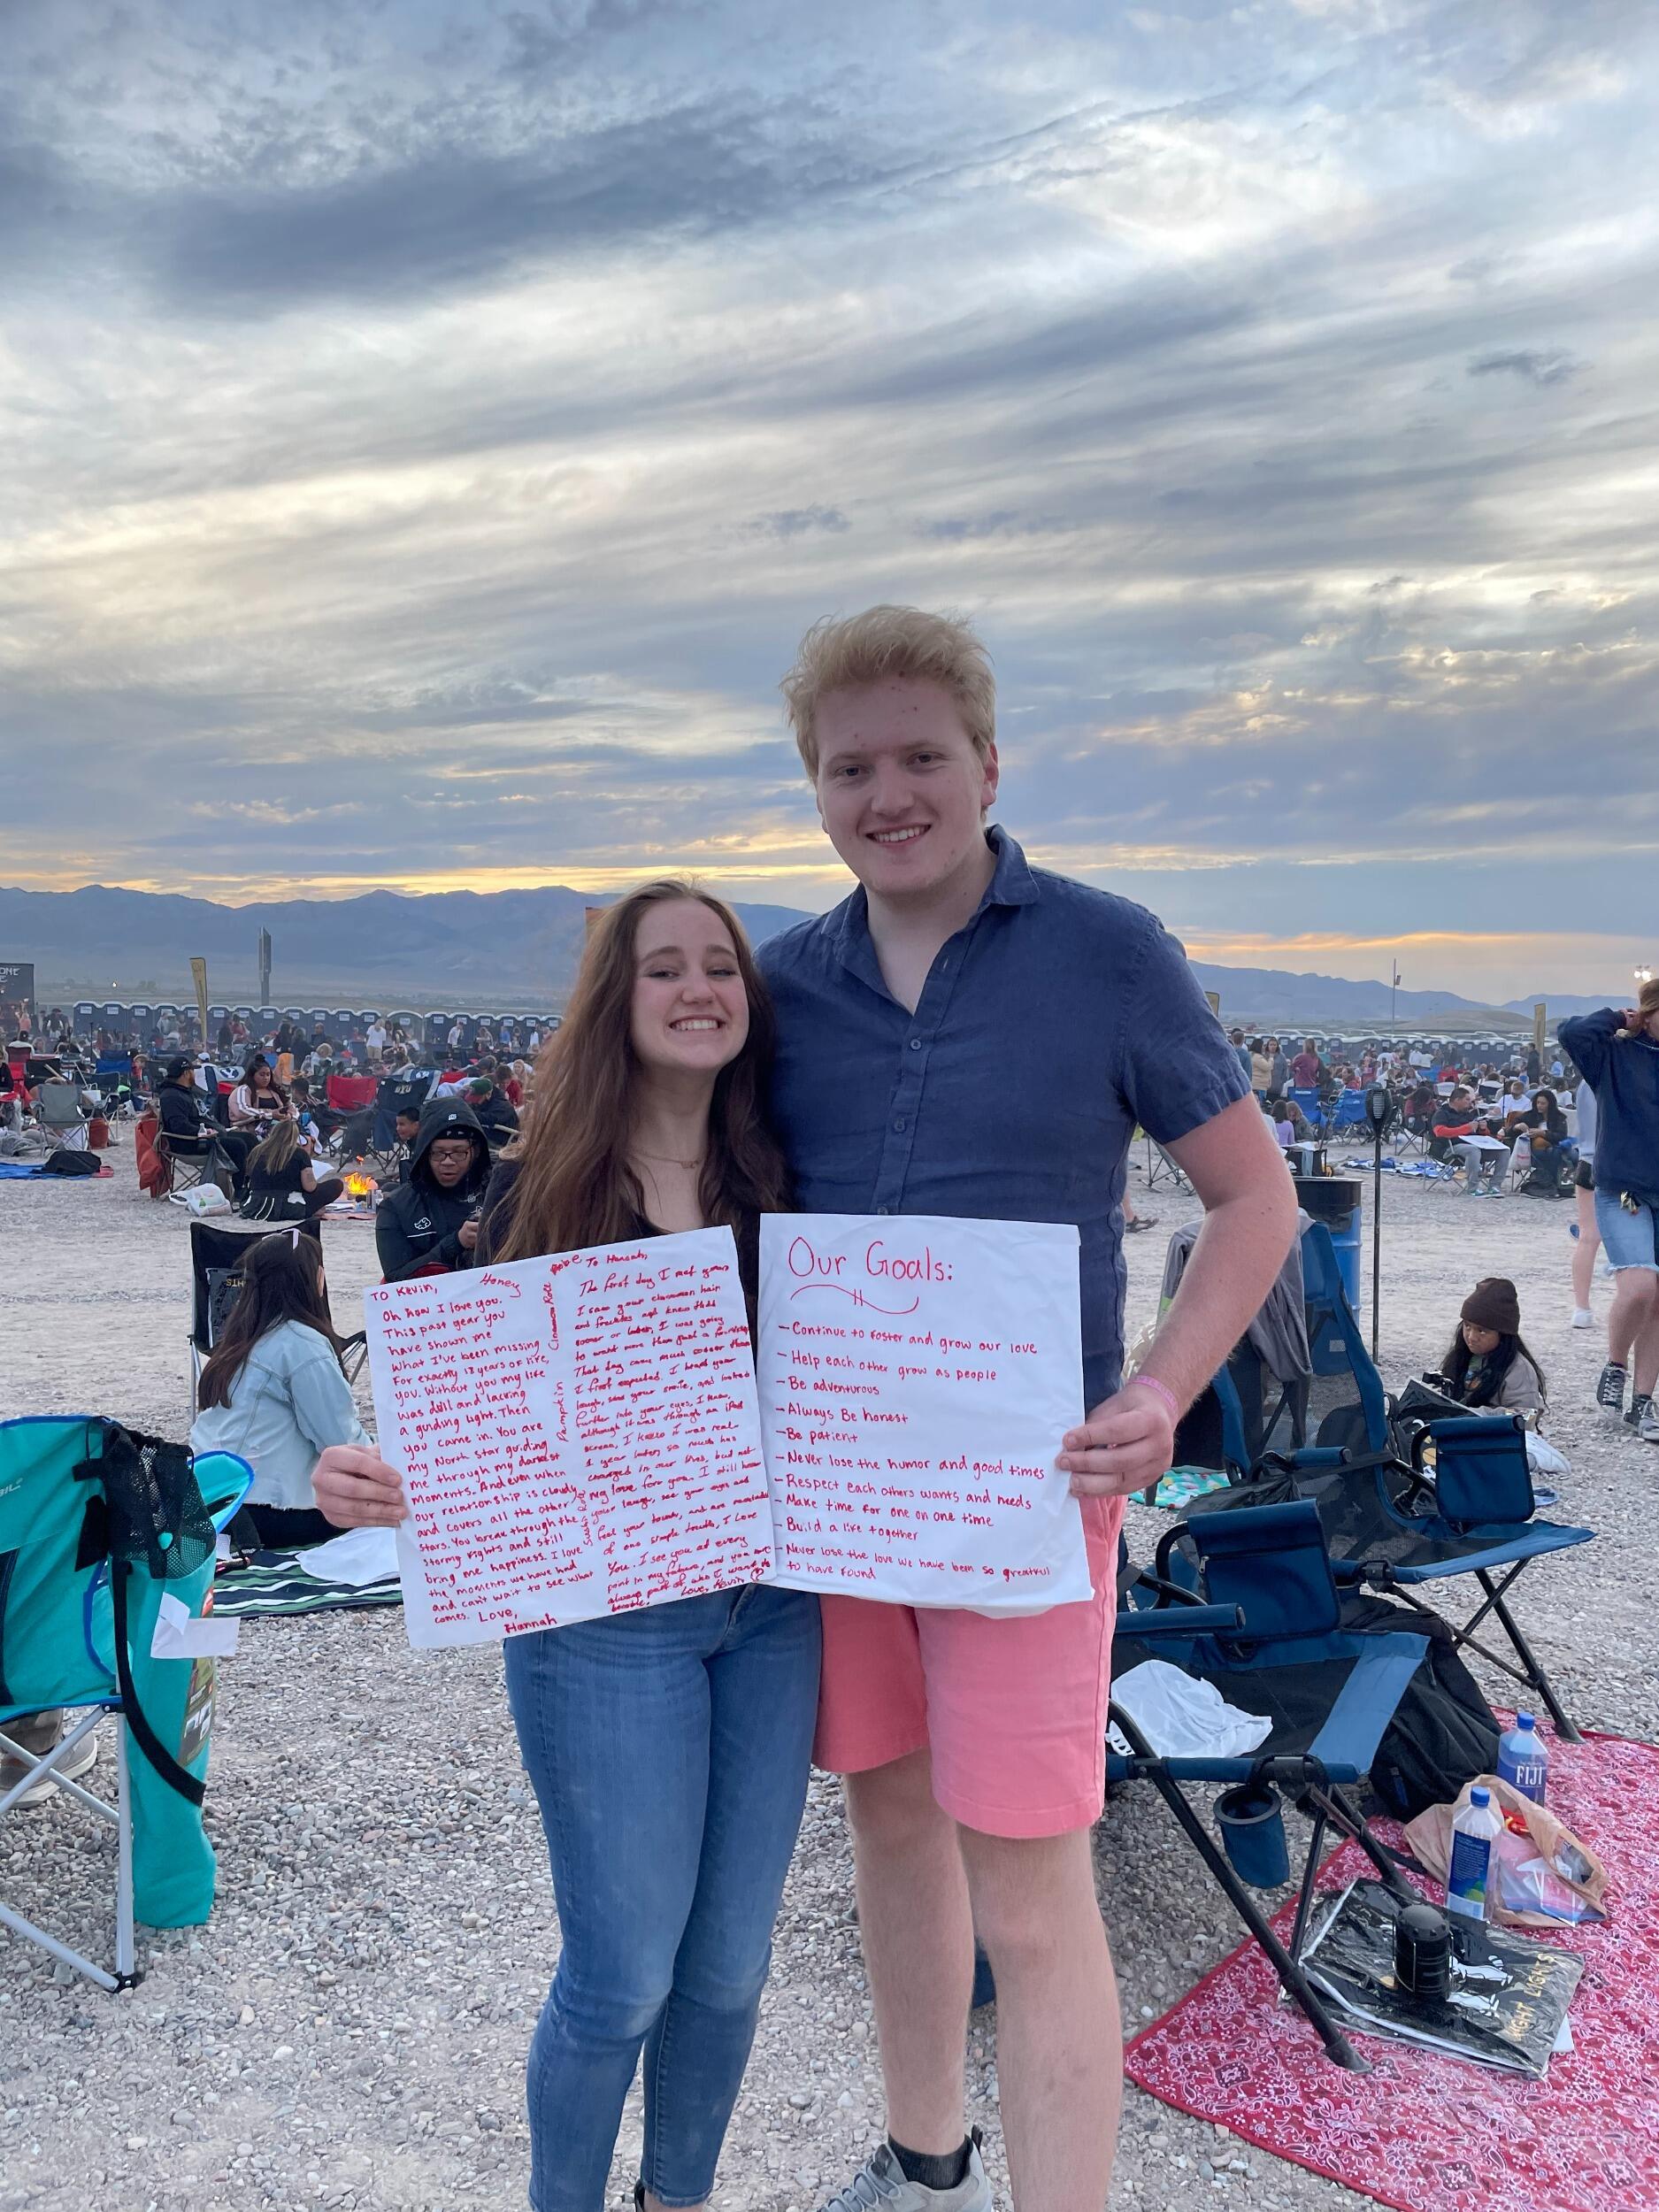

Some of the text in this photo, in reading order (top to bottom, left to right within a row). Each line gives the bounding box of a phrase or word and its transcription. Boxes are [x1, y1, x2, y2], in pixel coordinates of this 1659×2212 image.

[586, 1257, 597, 1267] To
[788, 1237, 953, 1281] Our Goals:
[396, 1284, 438, 1296] Kevin,
[480, 1273, 521, 1297] Honey
[580, 1265, 696, 1296] The first day I met
[701, 1285, 720, 1294] hair
[383, 1297, 502, 1322] Oh how I love you.
[383, 1311, 505, 1339] This past year you
[793, 1321, 1037, 1354] Continue to foster and grow our love
[388, 1331, 492, 1356] have shown me
[431, 1340, 540, 1364] I've been missing
[477, 1362, 505, 1377] years
[791, 1351, 996, 1381] Help each other grow as people
[395, 1371, 545, 1407] you. Without you my life
[788, 1376, 879, 1395] Be adventurous
[457, 1394, 481, 1409] and
[787, 1403, 908, 1425] Always Be honest
[416, 1417, 459, 1440] guiding
[498, 1405, 531, 1418] Then
[787, 1427, 858, 1445] Be patient
[403, 1443, 427, 1460] you
[437, 1437, 472, 1448] came
[496, 1426, 516, 1437] You
[522, 1422, 543, 1432] are
[408, 1438, 548, 1477] my North guiding
[787, 1450, 1045, 1479] Never lose the humor and good times
[437, 1463, 513, 1483] through my
[480, 1470, 566, 1492] And even when
[415, 1511, 434, 1522] our
[442, 1493, 520, 1516] relationship
[542, 1483, 577, 1503] cloudy
[787, 1474, 1032, 1509] Respect each others wants and needs
[418, 1502, 569, 1538] and covers all the other
[787, 1494, 995, 1527] Make time for one on one time
[419, 1515, 579, 1552] stars. You through the
[787, 1517, 822, 1532] Build
[830, 1524, 838, 1532] a
[870, 1526, 918, 1543] together
[424, 1533, 563, 1569] stormy and still
[640, 1552, 649, 1566] I
[650, 1555, 666, 1563] see
[671, 1548, 693, 1561] you
[716, 1535, 748, 1548] every
[787, 1544, 816, 1555] Never
[820, 1546, 842, 1557] lose
[847, 1547, 869, 1560] the
[875, 1552, 893, 1564] love
[898, 1557, 913, 1568] we
[919, 1558, 945, 1571] have
[951, 1562, 973, 1572] been
[983, 1566, 995, 1575] so
[425, 1572, 455, 1587] bring
[463, 1568, 482, 1578] me
[490, 1553, 547, 1572] happiness.
[563, 1547, 583, 1557] love
[429, 1589, 449, 1599] the
[457, 1579, 506, 1595] moments
[527, 1570, 552, 1579] have
[556, 1560, 577, 1574] had
[787, 1562, 877, 1579] to have found
[433, 1601, 457, 1612] and
[462, 1596, 487, 1608] can't
[493, 1589, 520, 1601] wait
[547, 1578, 565, 1588] see
[479, 1608, 518, 1623] Love,
[504, 1613, 557, 1633] Hannah
[1516, 1765, 1543, 1786] FIJI
